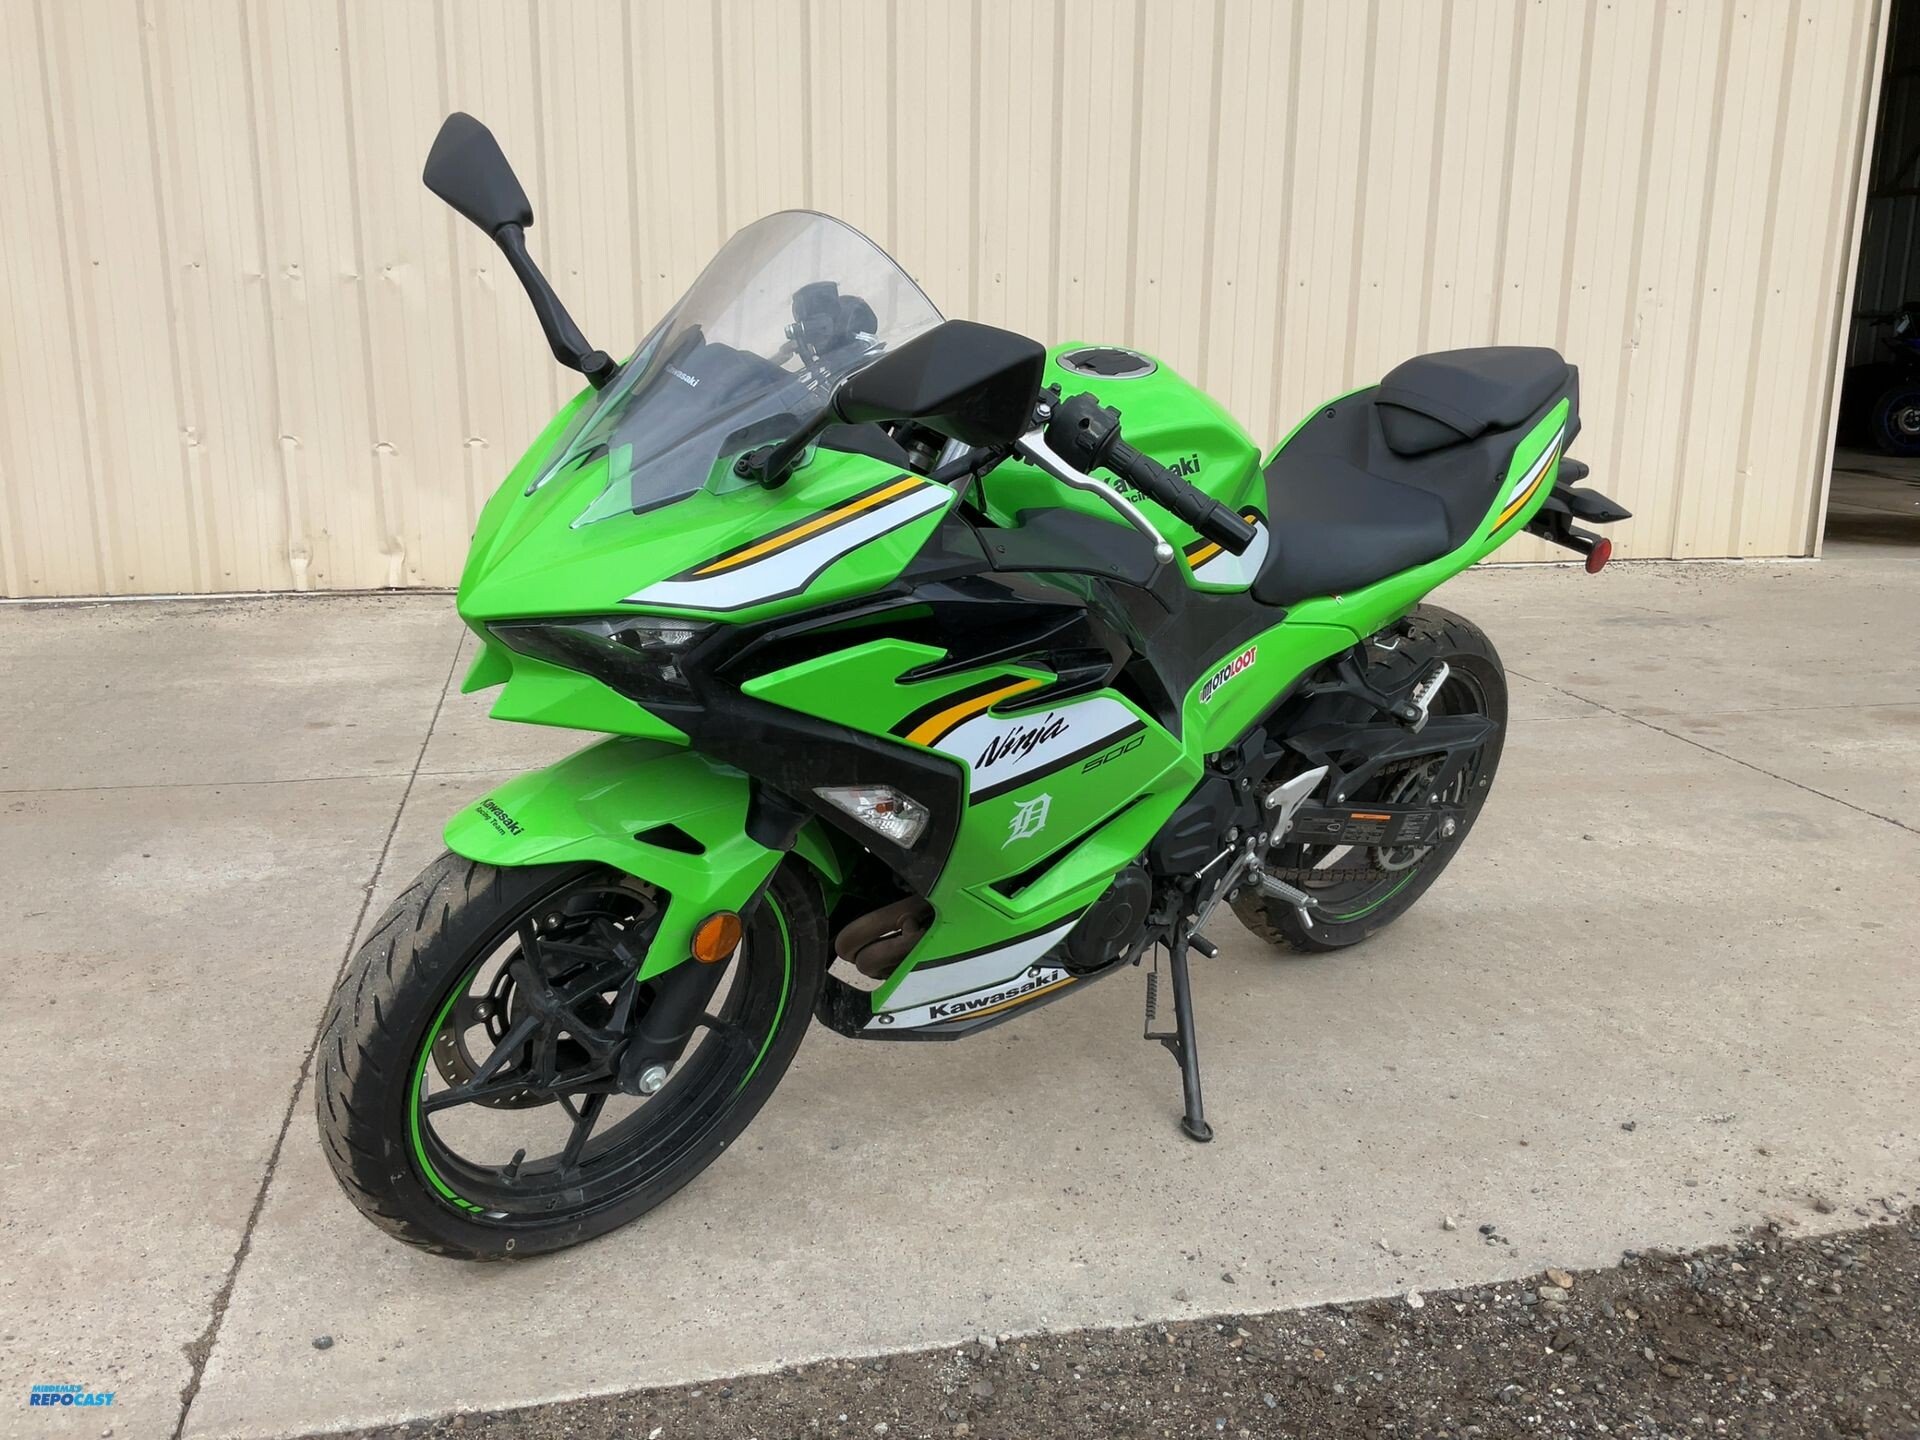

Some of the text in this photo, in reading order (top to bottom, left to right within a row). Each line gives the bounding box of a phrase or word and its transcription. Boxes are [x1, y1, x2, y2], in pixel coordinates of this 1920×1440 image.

[974, 712, 1070, 770] Ninja
[1081, 735, 1145, 775] 500
[480, 798, 525, 836] Kawasaki
[490, 818, 506, 836] Team
[1001, 793, 1053, 850] D
[929, 969, 1059, 1020] Kawasaki
